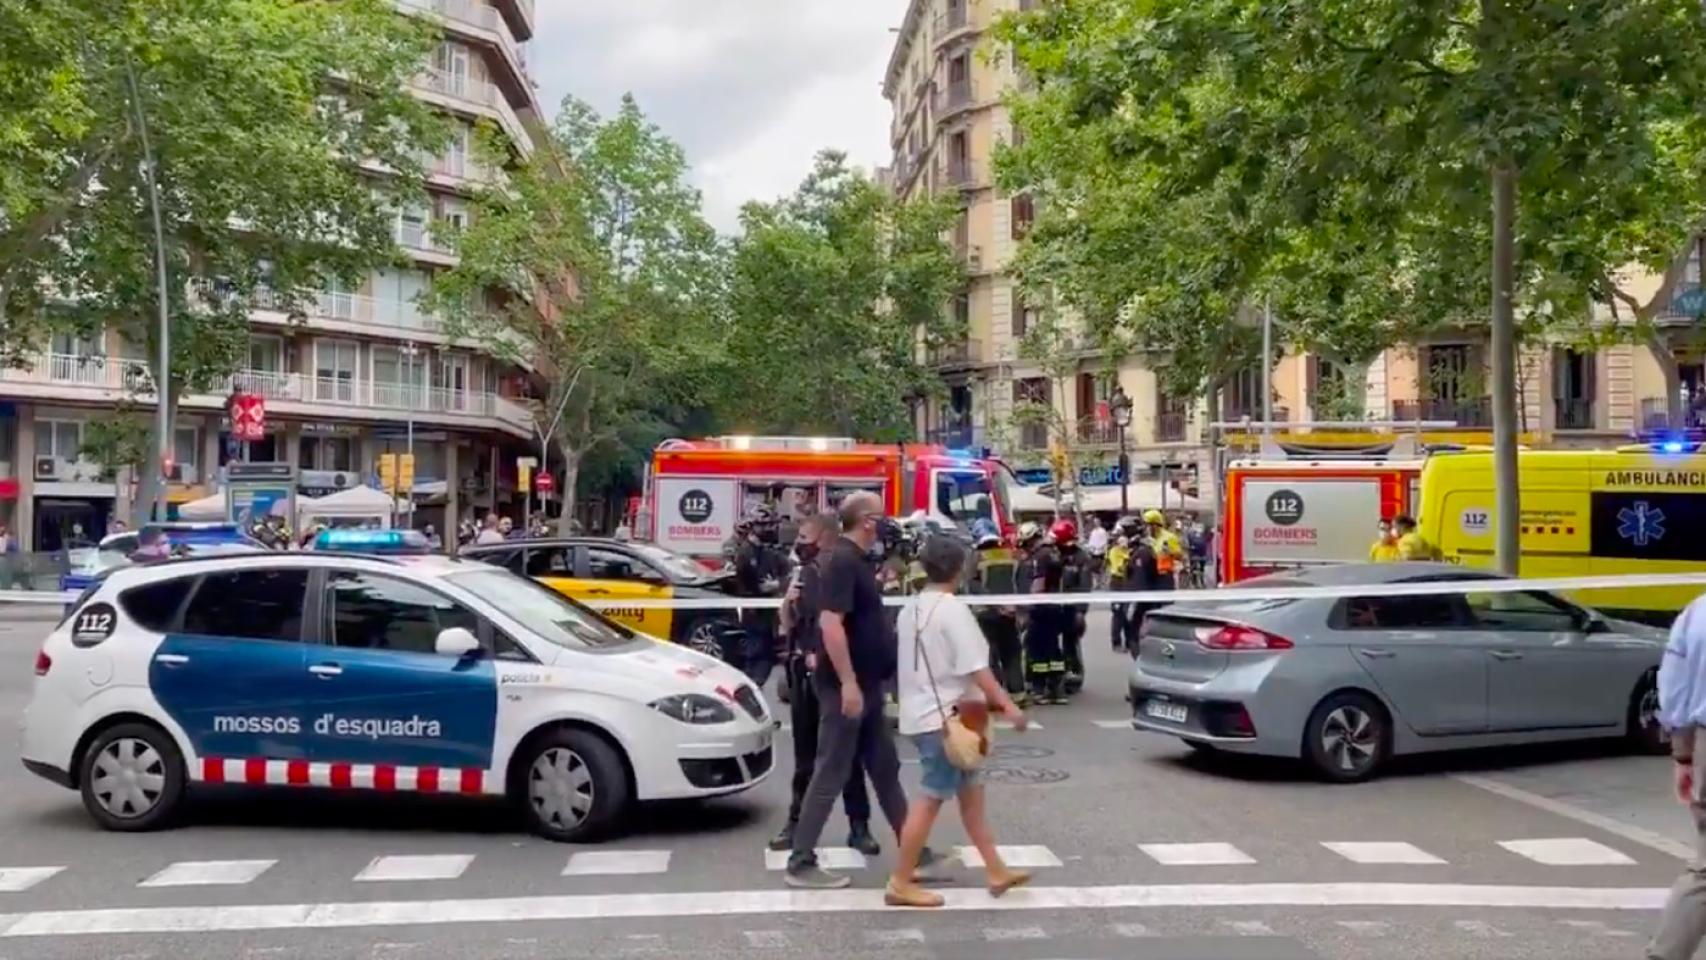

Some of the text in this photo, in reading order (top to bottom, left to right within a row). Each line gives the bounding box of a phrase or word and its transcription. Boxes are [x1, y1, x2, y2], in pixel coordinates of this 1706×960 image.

[685, 498, 707, 511] 112
[1272, 498, 1297, 512] 112
[1464, 513, 1488, 525] 112
[668, 526, 721, 536] BOMBERS
[1254, 527, 1318, 539] BOMBERS
[79, 614, 112, 631] 112
[213, 713, 442, 740] mossos d'esquadra
